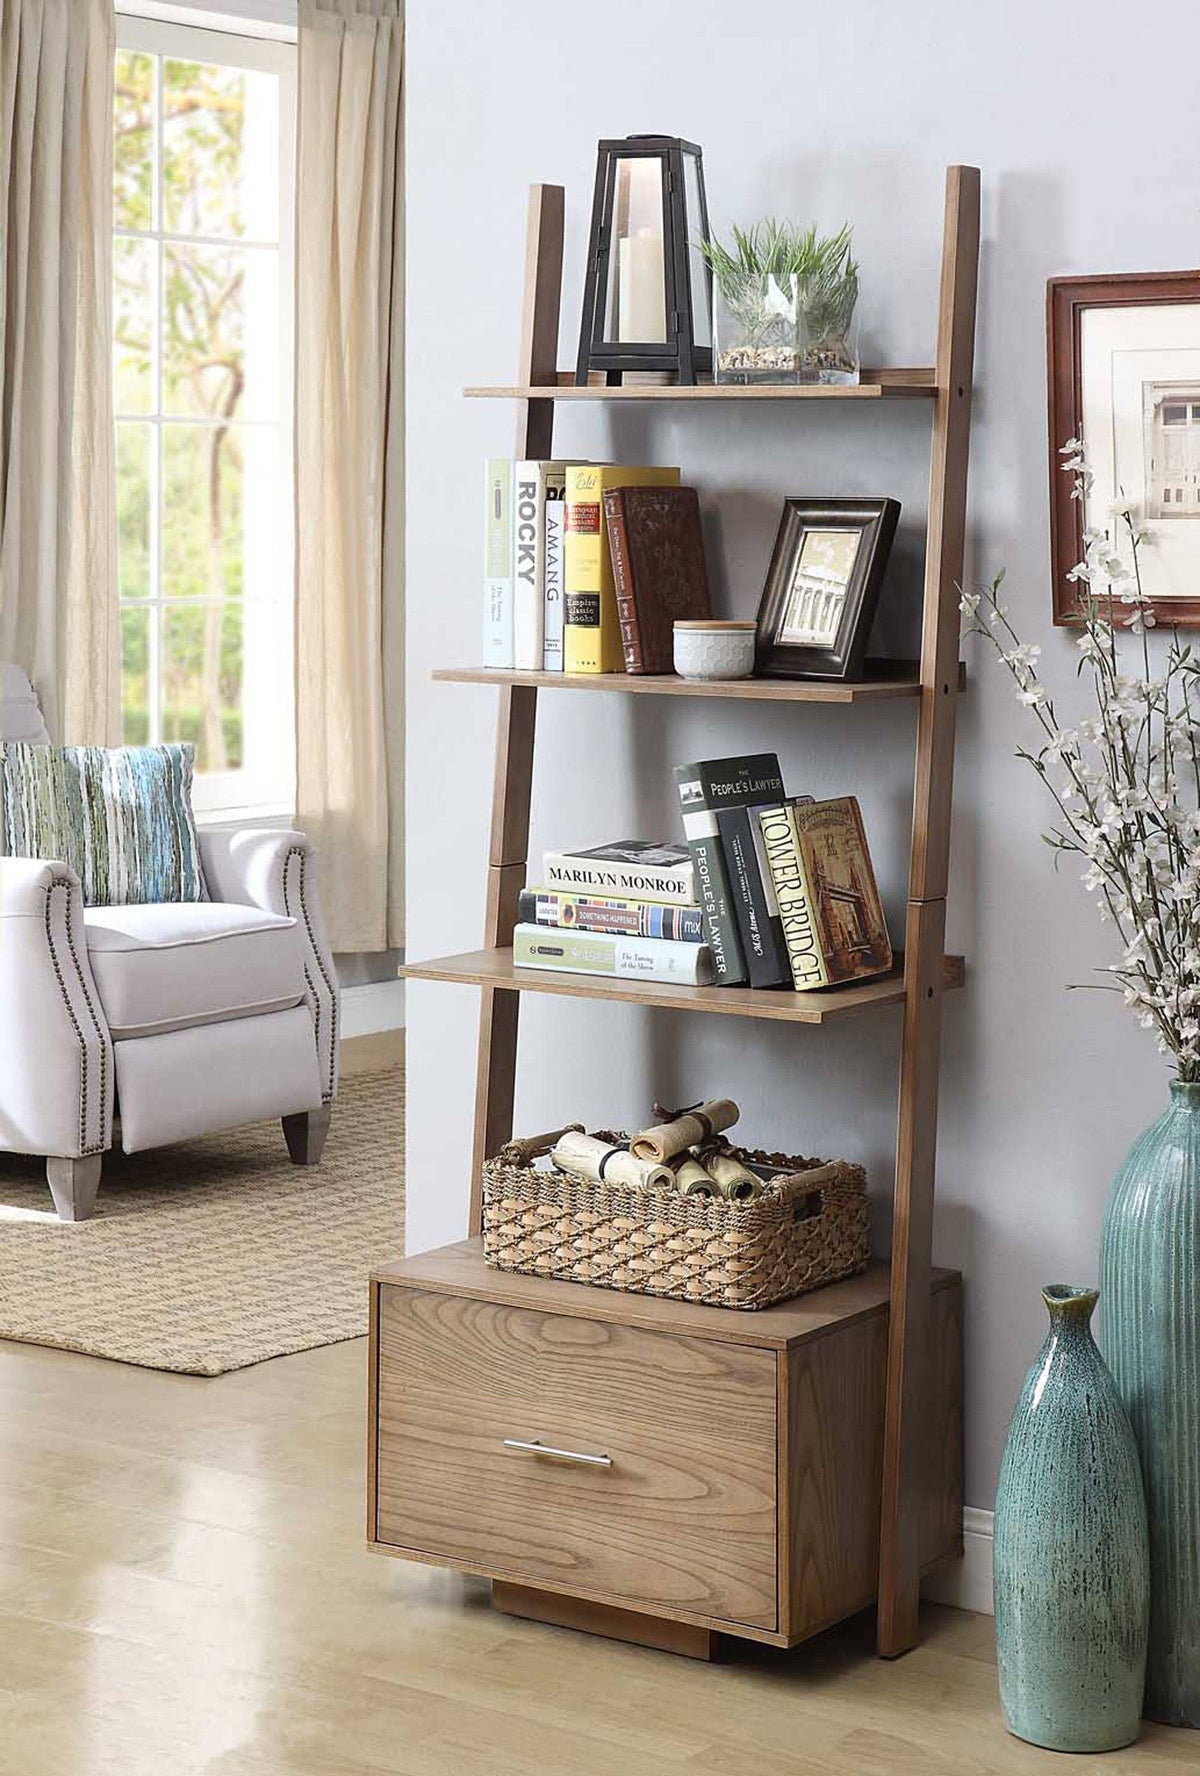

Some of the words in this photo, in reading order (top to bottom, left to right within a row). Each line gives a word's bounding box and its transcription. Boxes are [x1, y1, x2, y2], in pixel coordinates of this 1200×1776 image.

[518, 482, 536, 586] ROCKY
[547, 518, 559, 601] AMANG
[569, 614, 593, 622] books
[710, 780, 749, 796] PEOPLE'S
[748, 778, 781, 791] LAWYER
[761, 809, 803, 894] TOWER
[549, 867, 616, 885] MARILYN
[620, 875, 686, 894] MONROE
[718, 900, 726, 916] THE
[579, 911, 610, 922] SOMETHING
[696, 847, 715, 912] PEOPLE'S
[709, 915, 727, 974] LAWYER
[779, 896, 823, 986] BRIDGE
